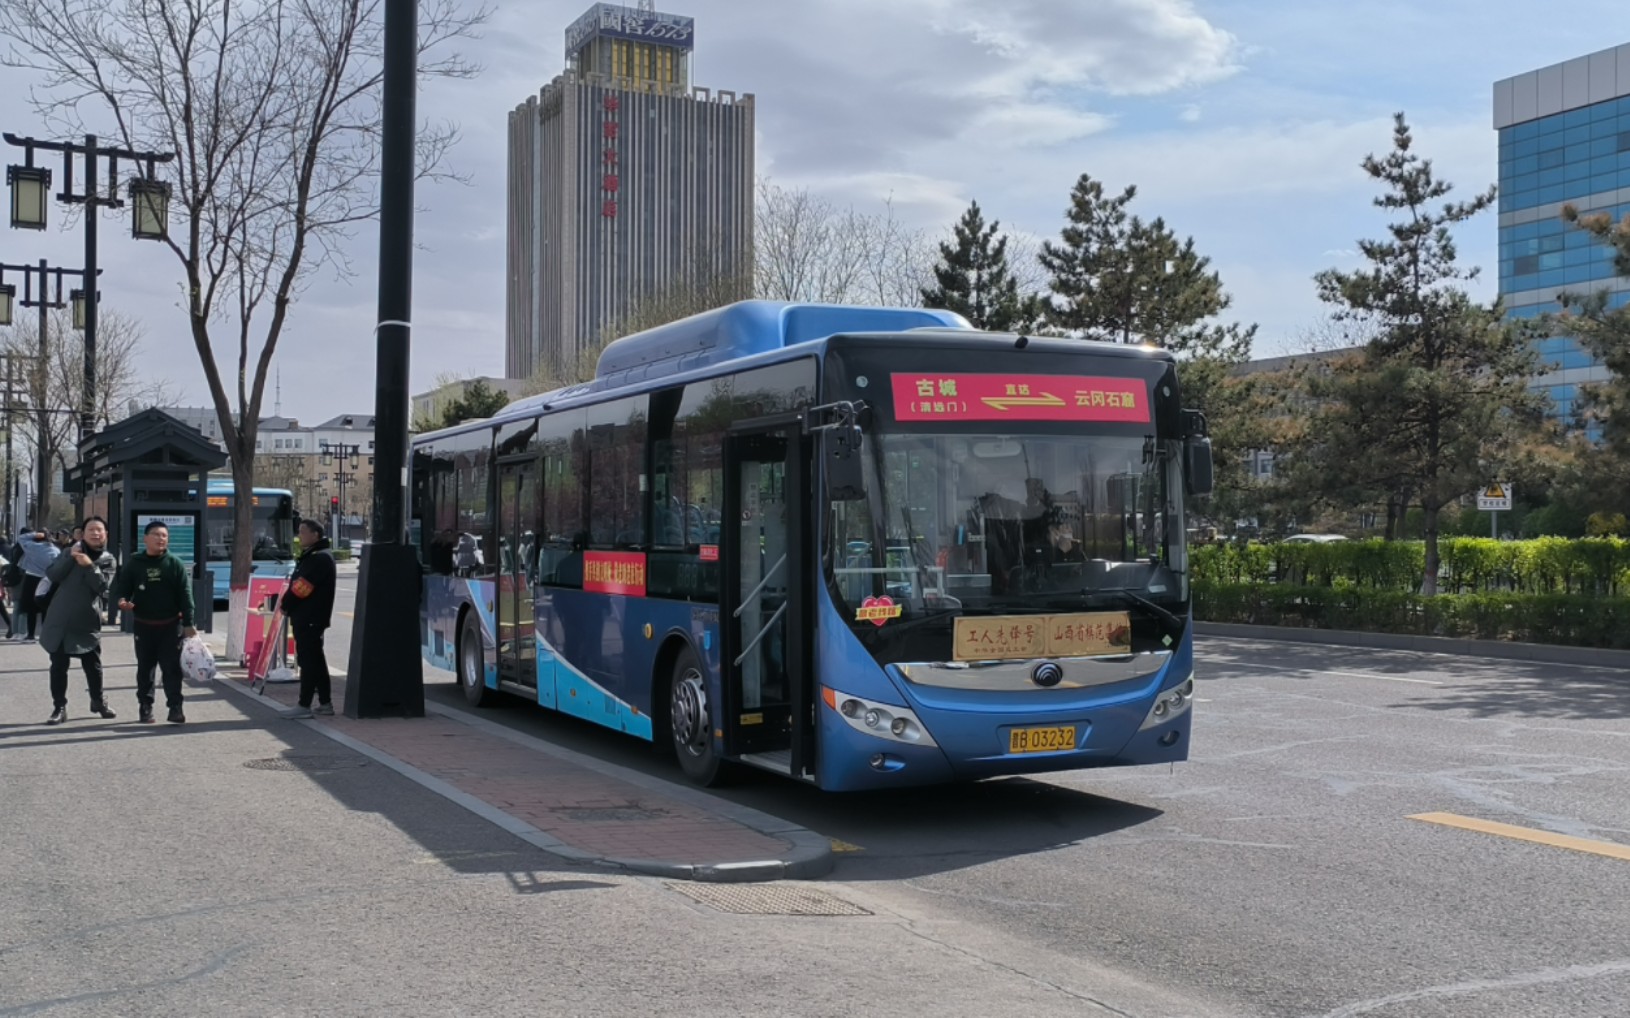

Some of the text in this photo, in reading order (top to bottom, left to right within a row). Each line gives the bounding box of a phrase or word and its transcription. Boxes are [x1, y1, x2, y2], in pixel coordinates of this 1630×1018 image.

[916, 379, 958, 396] 古城
[1005, 384, 1030, 396] 直达
[1074, 390, 1136, 408] 云冈石窟
[966, 624, 1036, 645] 工人先锋号
[1054, 622, 1125, 643] 山西省模范集
